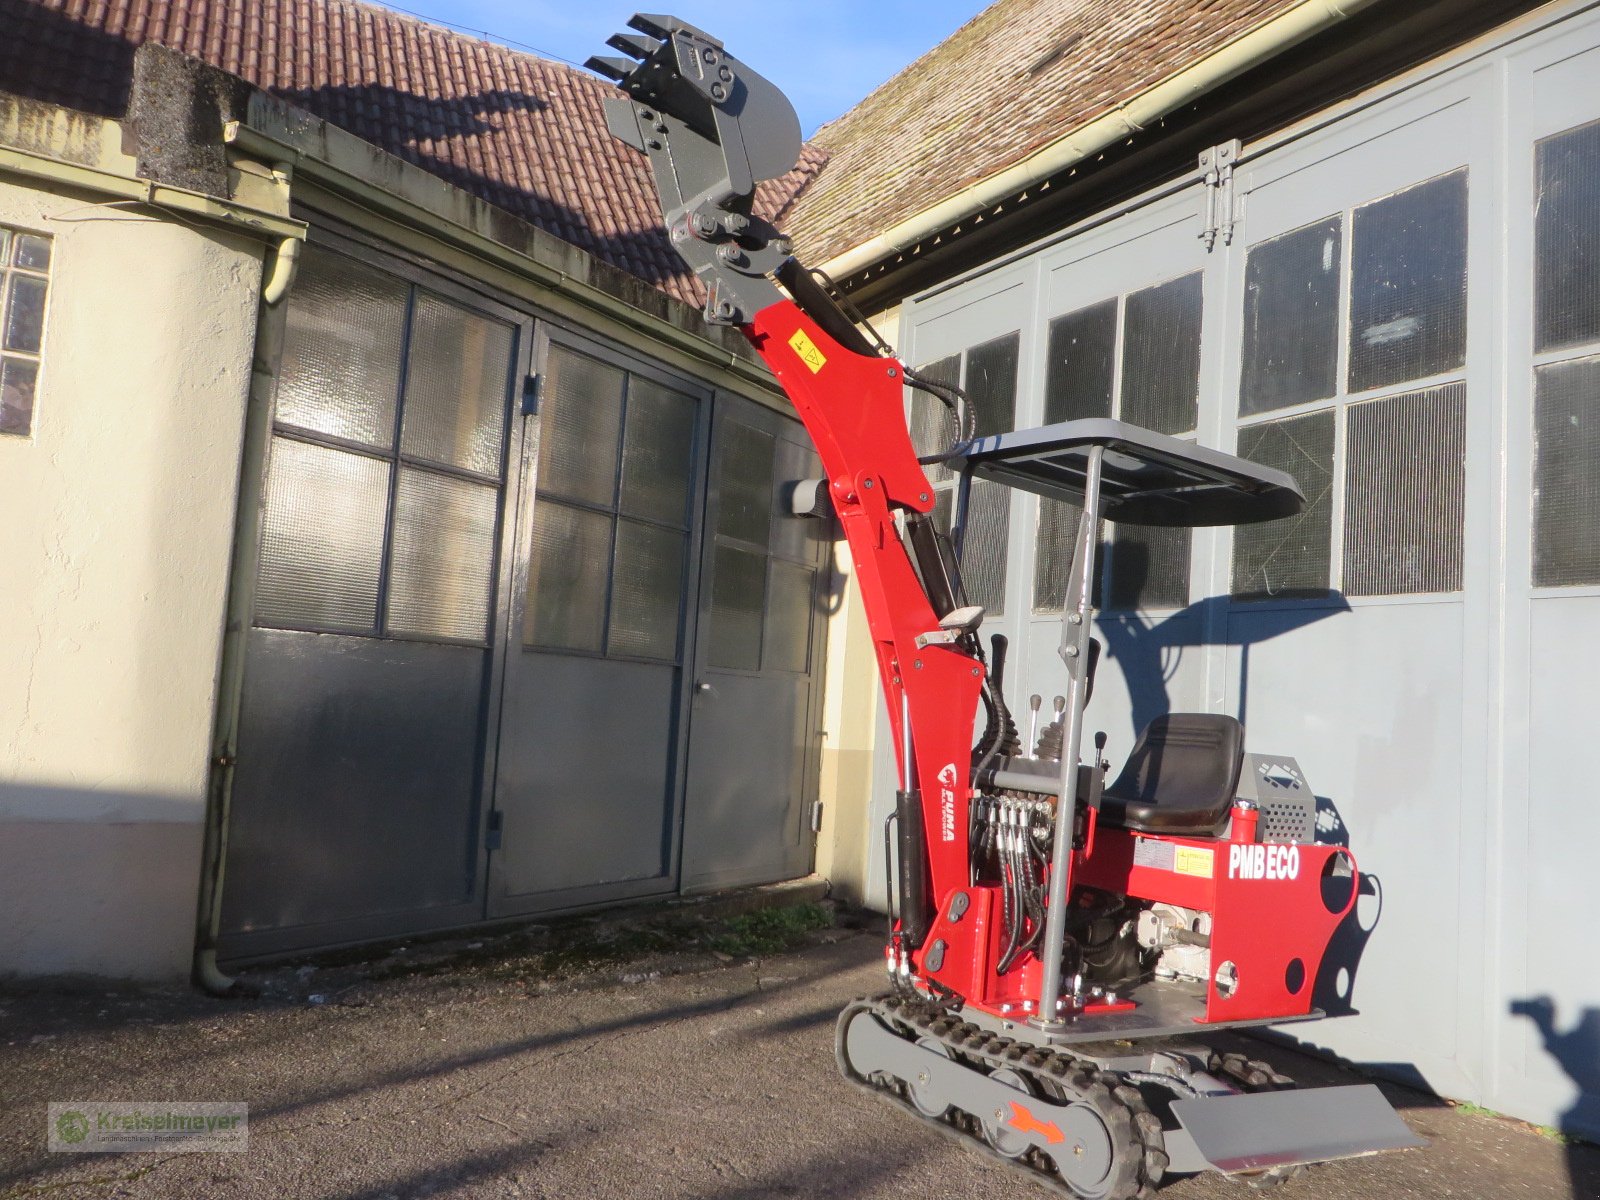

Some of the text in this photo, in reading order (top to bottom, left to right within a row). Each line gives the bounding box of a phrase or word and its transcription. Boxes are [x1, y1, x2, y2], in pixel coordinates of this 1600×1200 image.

[945, 789, 955, 841] PUMA
[1229, 844, 1265, 879] PMB
[1266, 845, 1299, 880] ECO
